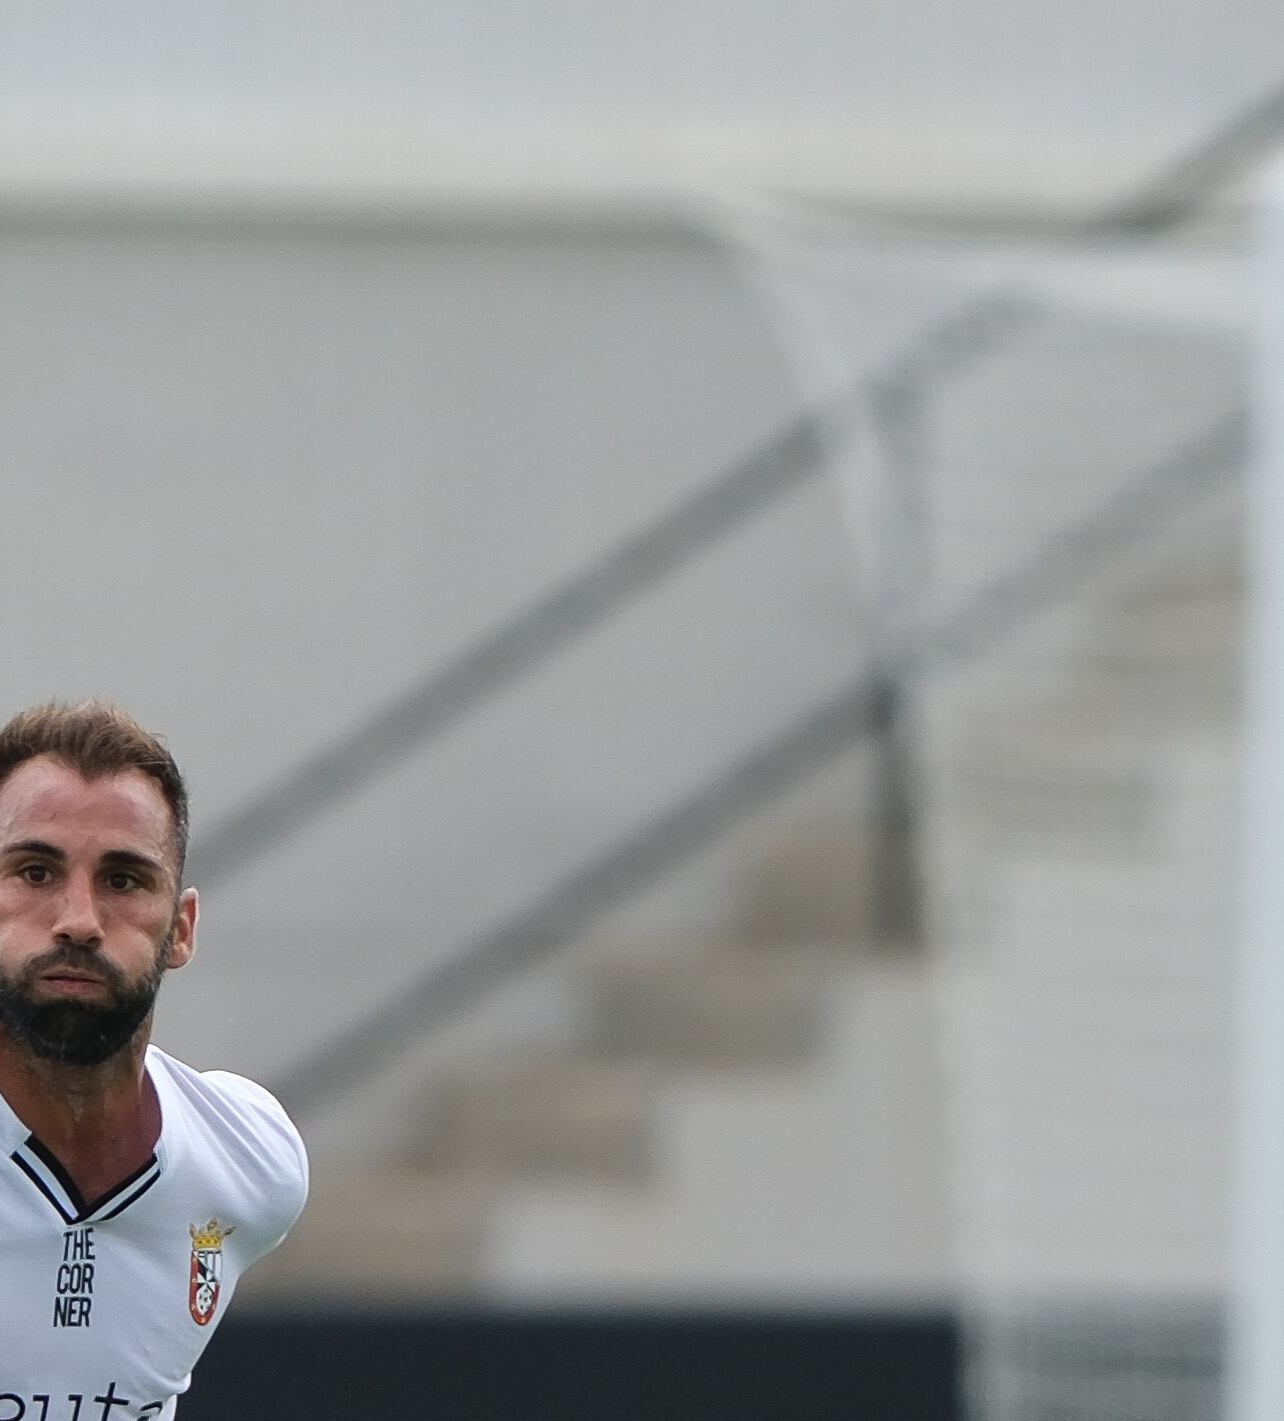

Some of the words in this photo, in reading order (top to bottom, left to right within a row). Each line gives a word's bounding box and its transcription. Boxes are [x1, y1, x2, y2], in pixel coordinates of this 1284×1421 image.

[62, 1227, 96, 1261] THE
[56, 1262, 95, 1295] COR
[53, 1296, 93, 1328] NER
